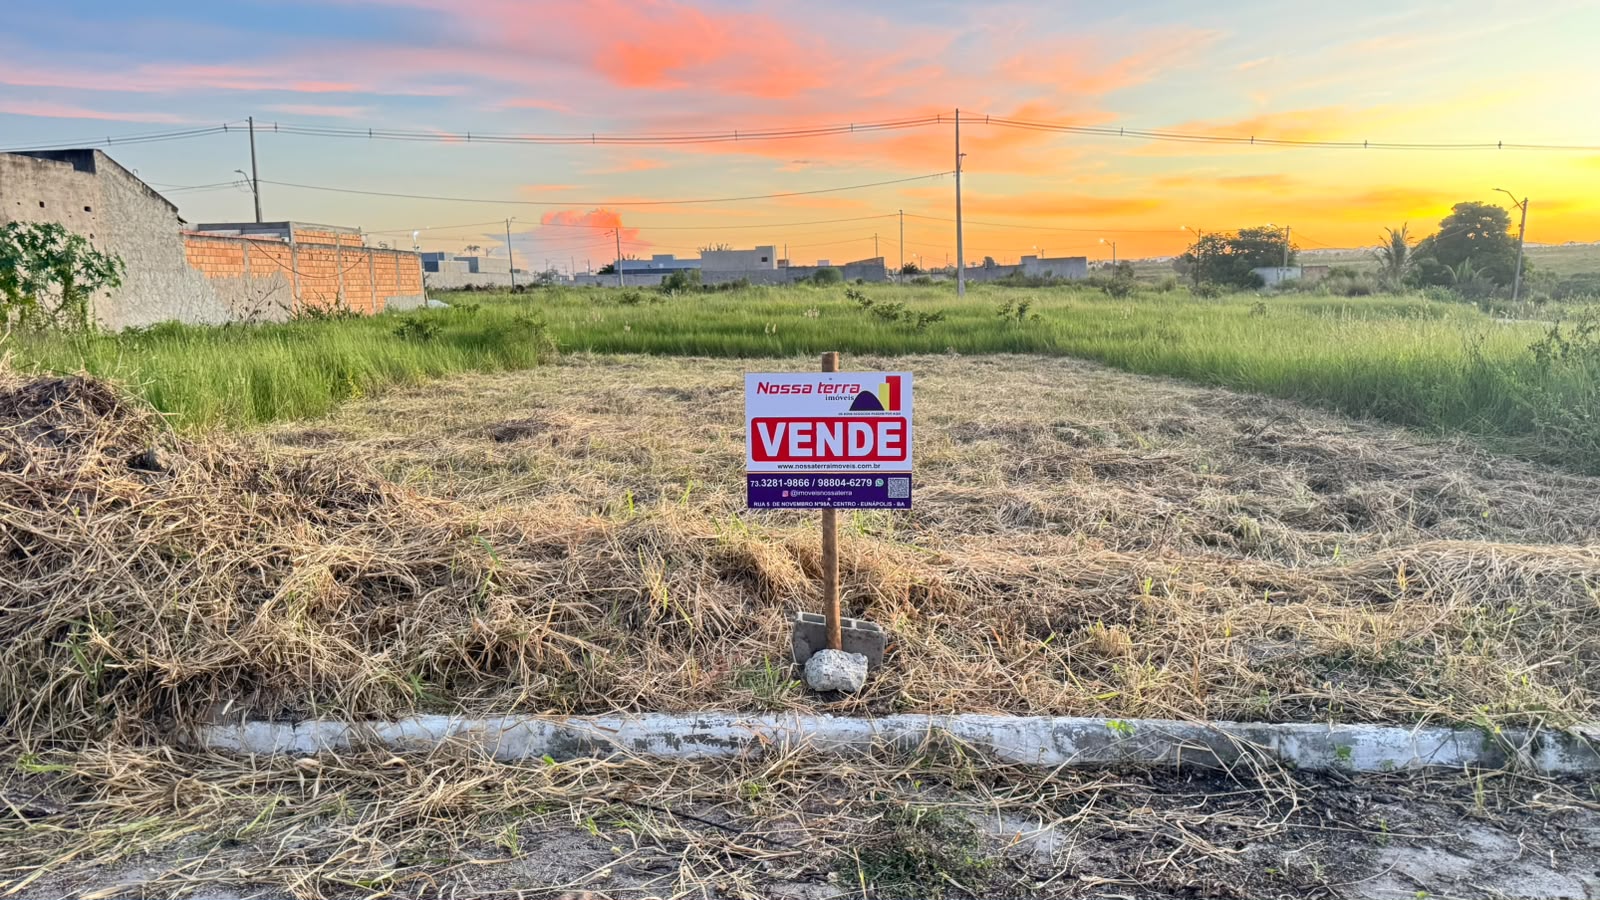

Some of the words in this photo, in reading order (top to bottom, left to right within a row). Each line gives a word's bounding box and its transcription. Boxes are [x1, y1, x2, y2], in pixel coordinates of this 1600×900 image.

[756, 381, 813, 394] Nossa
[817, 381, 861, 394] terra
[756, 421, 902, 457] VENDE
[817, 478, 873, 487] 98804-6279
